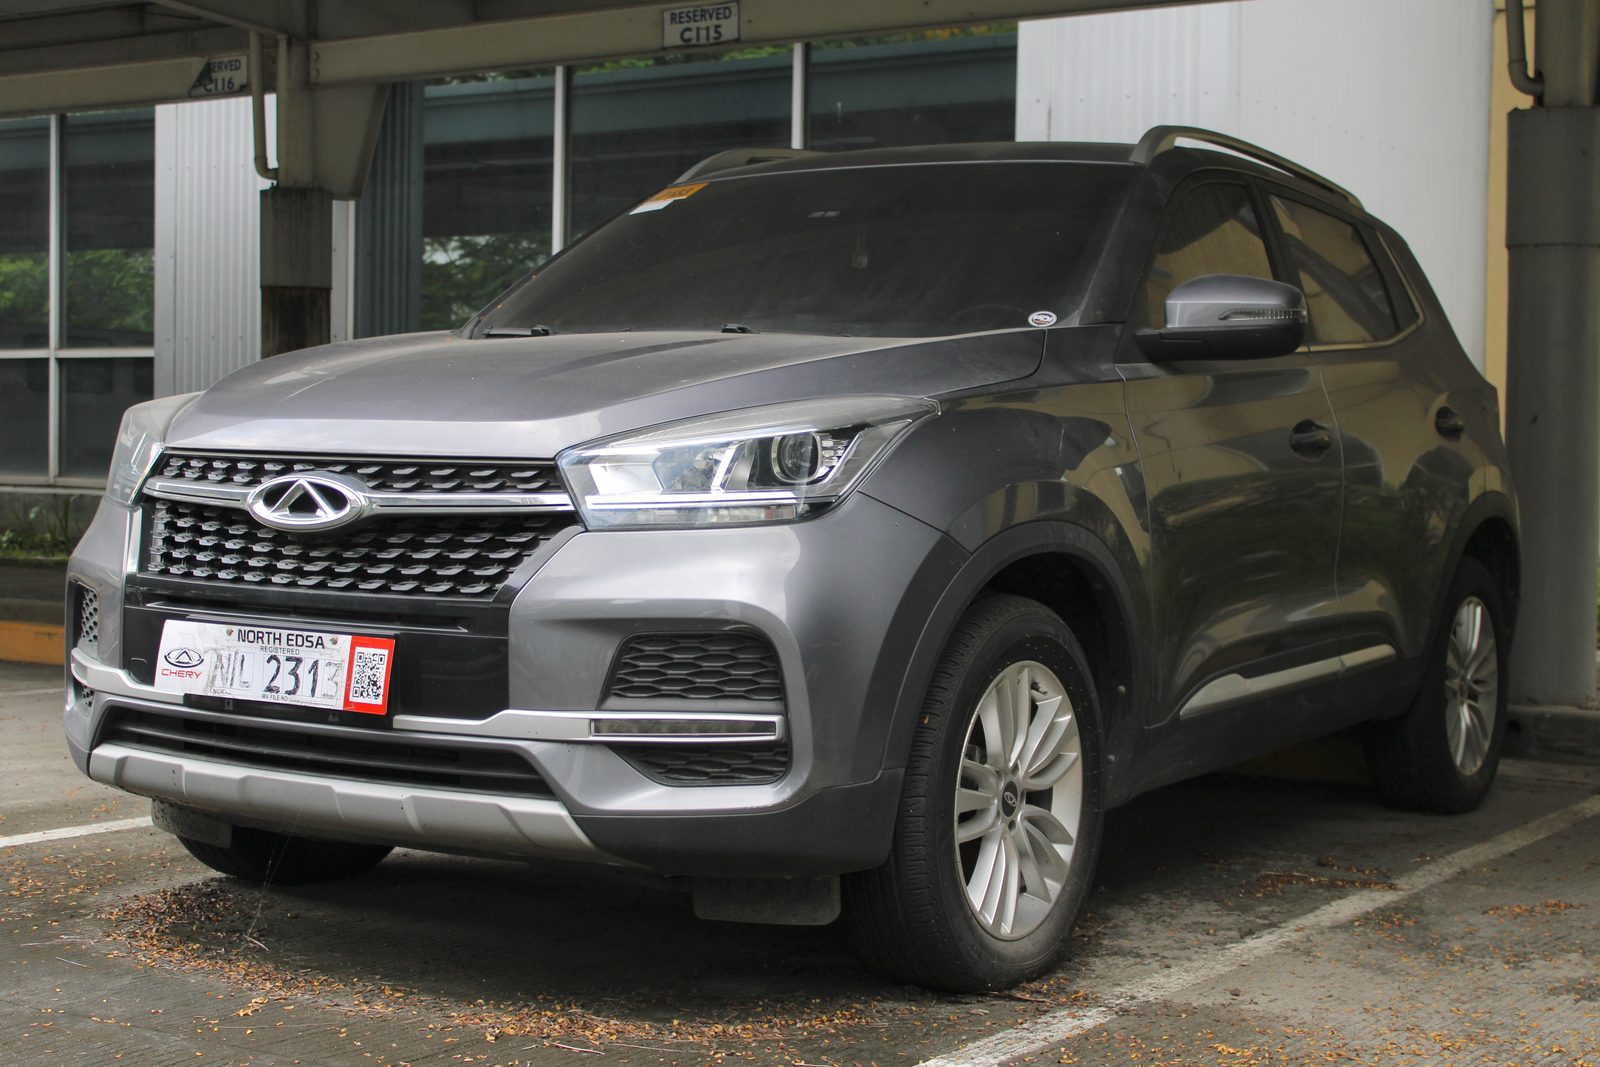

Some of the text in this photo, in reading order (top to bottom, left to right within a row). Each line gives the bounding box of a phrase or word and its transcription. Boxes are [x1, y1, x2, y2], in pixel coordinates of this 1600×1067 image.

[670, 6, 732, 25] RESERVED
[680, 25, 722, 43] C115
[210, 59, 241, 73] ERVED
[237, 629, 325, 649] NORTH EDSA
[260, 646, 300, 655] REGISTERED
[161, 668, 202, 679] CHERY
